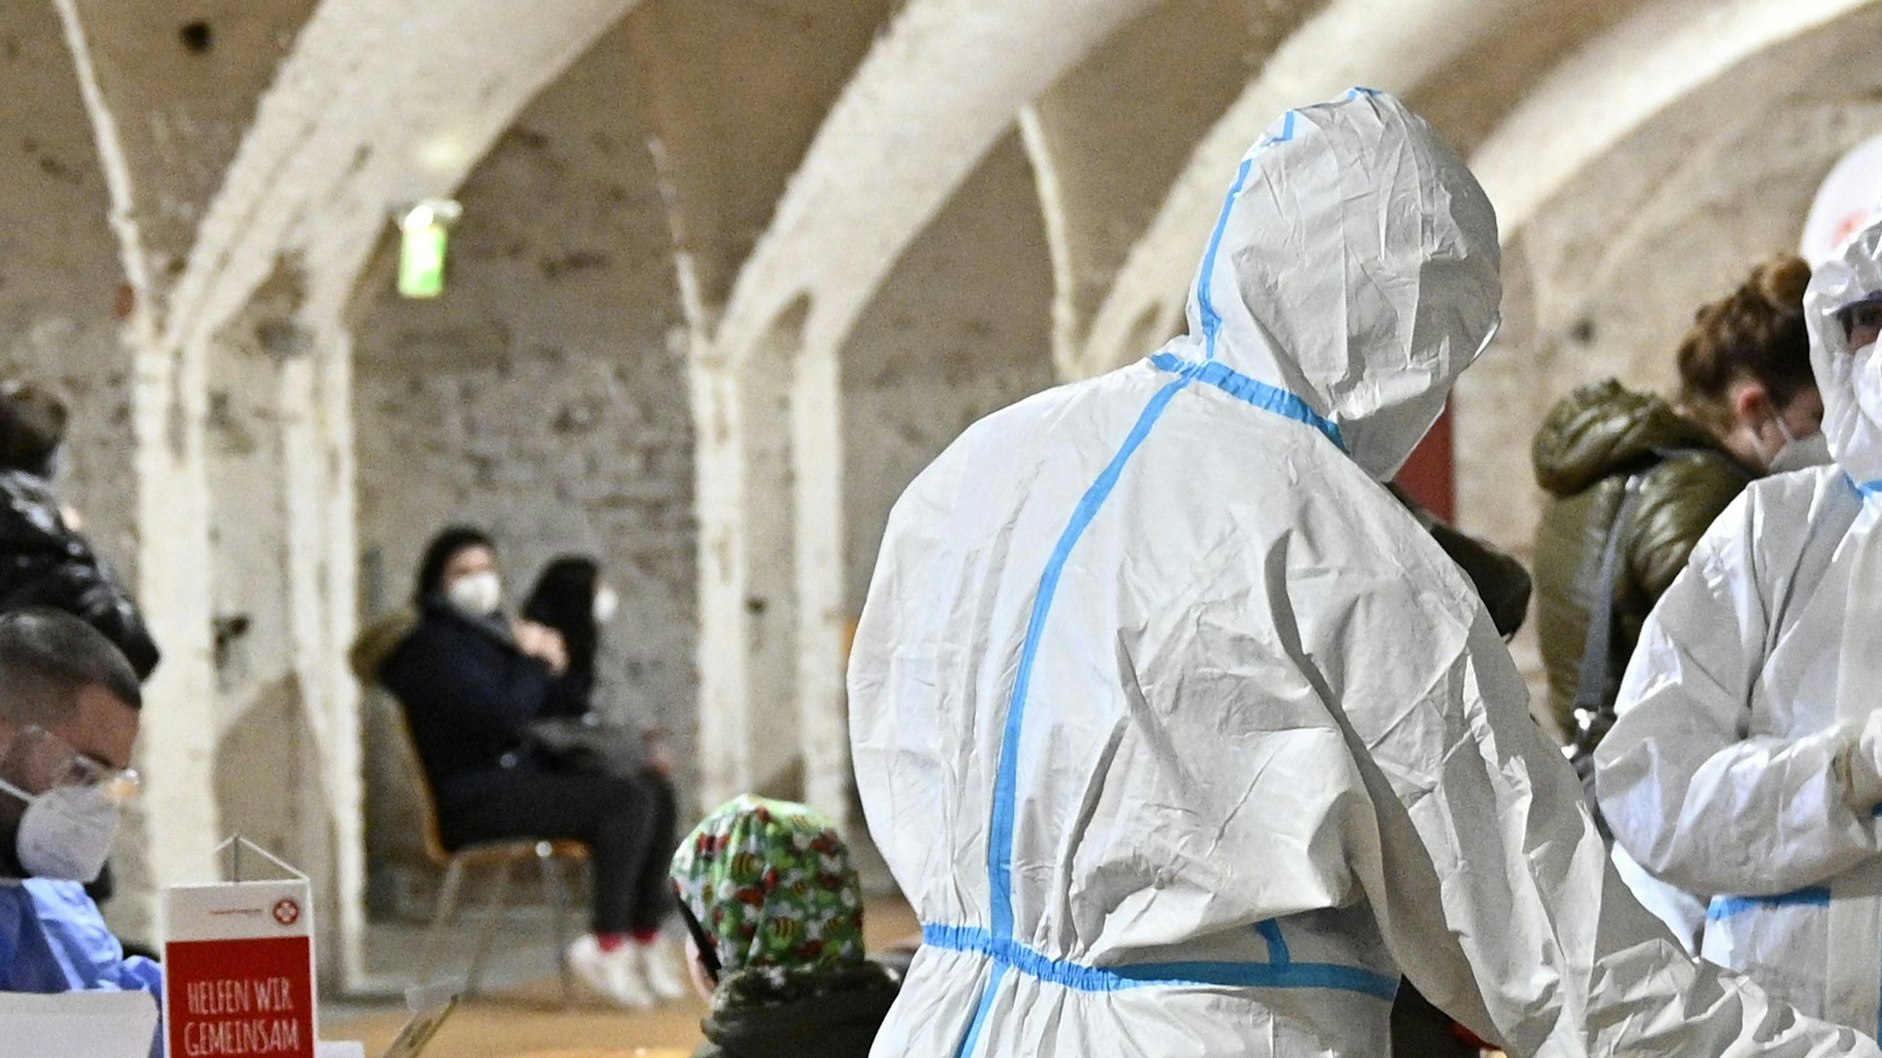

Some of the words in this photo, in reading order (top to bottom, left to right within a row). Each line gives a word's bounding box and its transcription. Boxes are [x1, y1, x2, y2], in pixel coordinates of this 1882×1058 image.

[187, 979, 250, 1015] HELFEN
[254, 976, 293, 1013] WIR
[184, 1018, 300, 1057] GEMEINSAM
